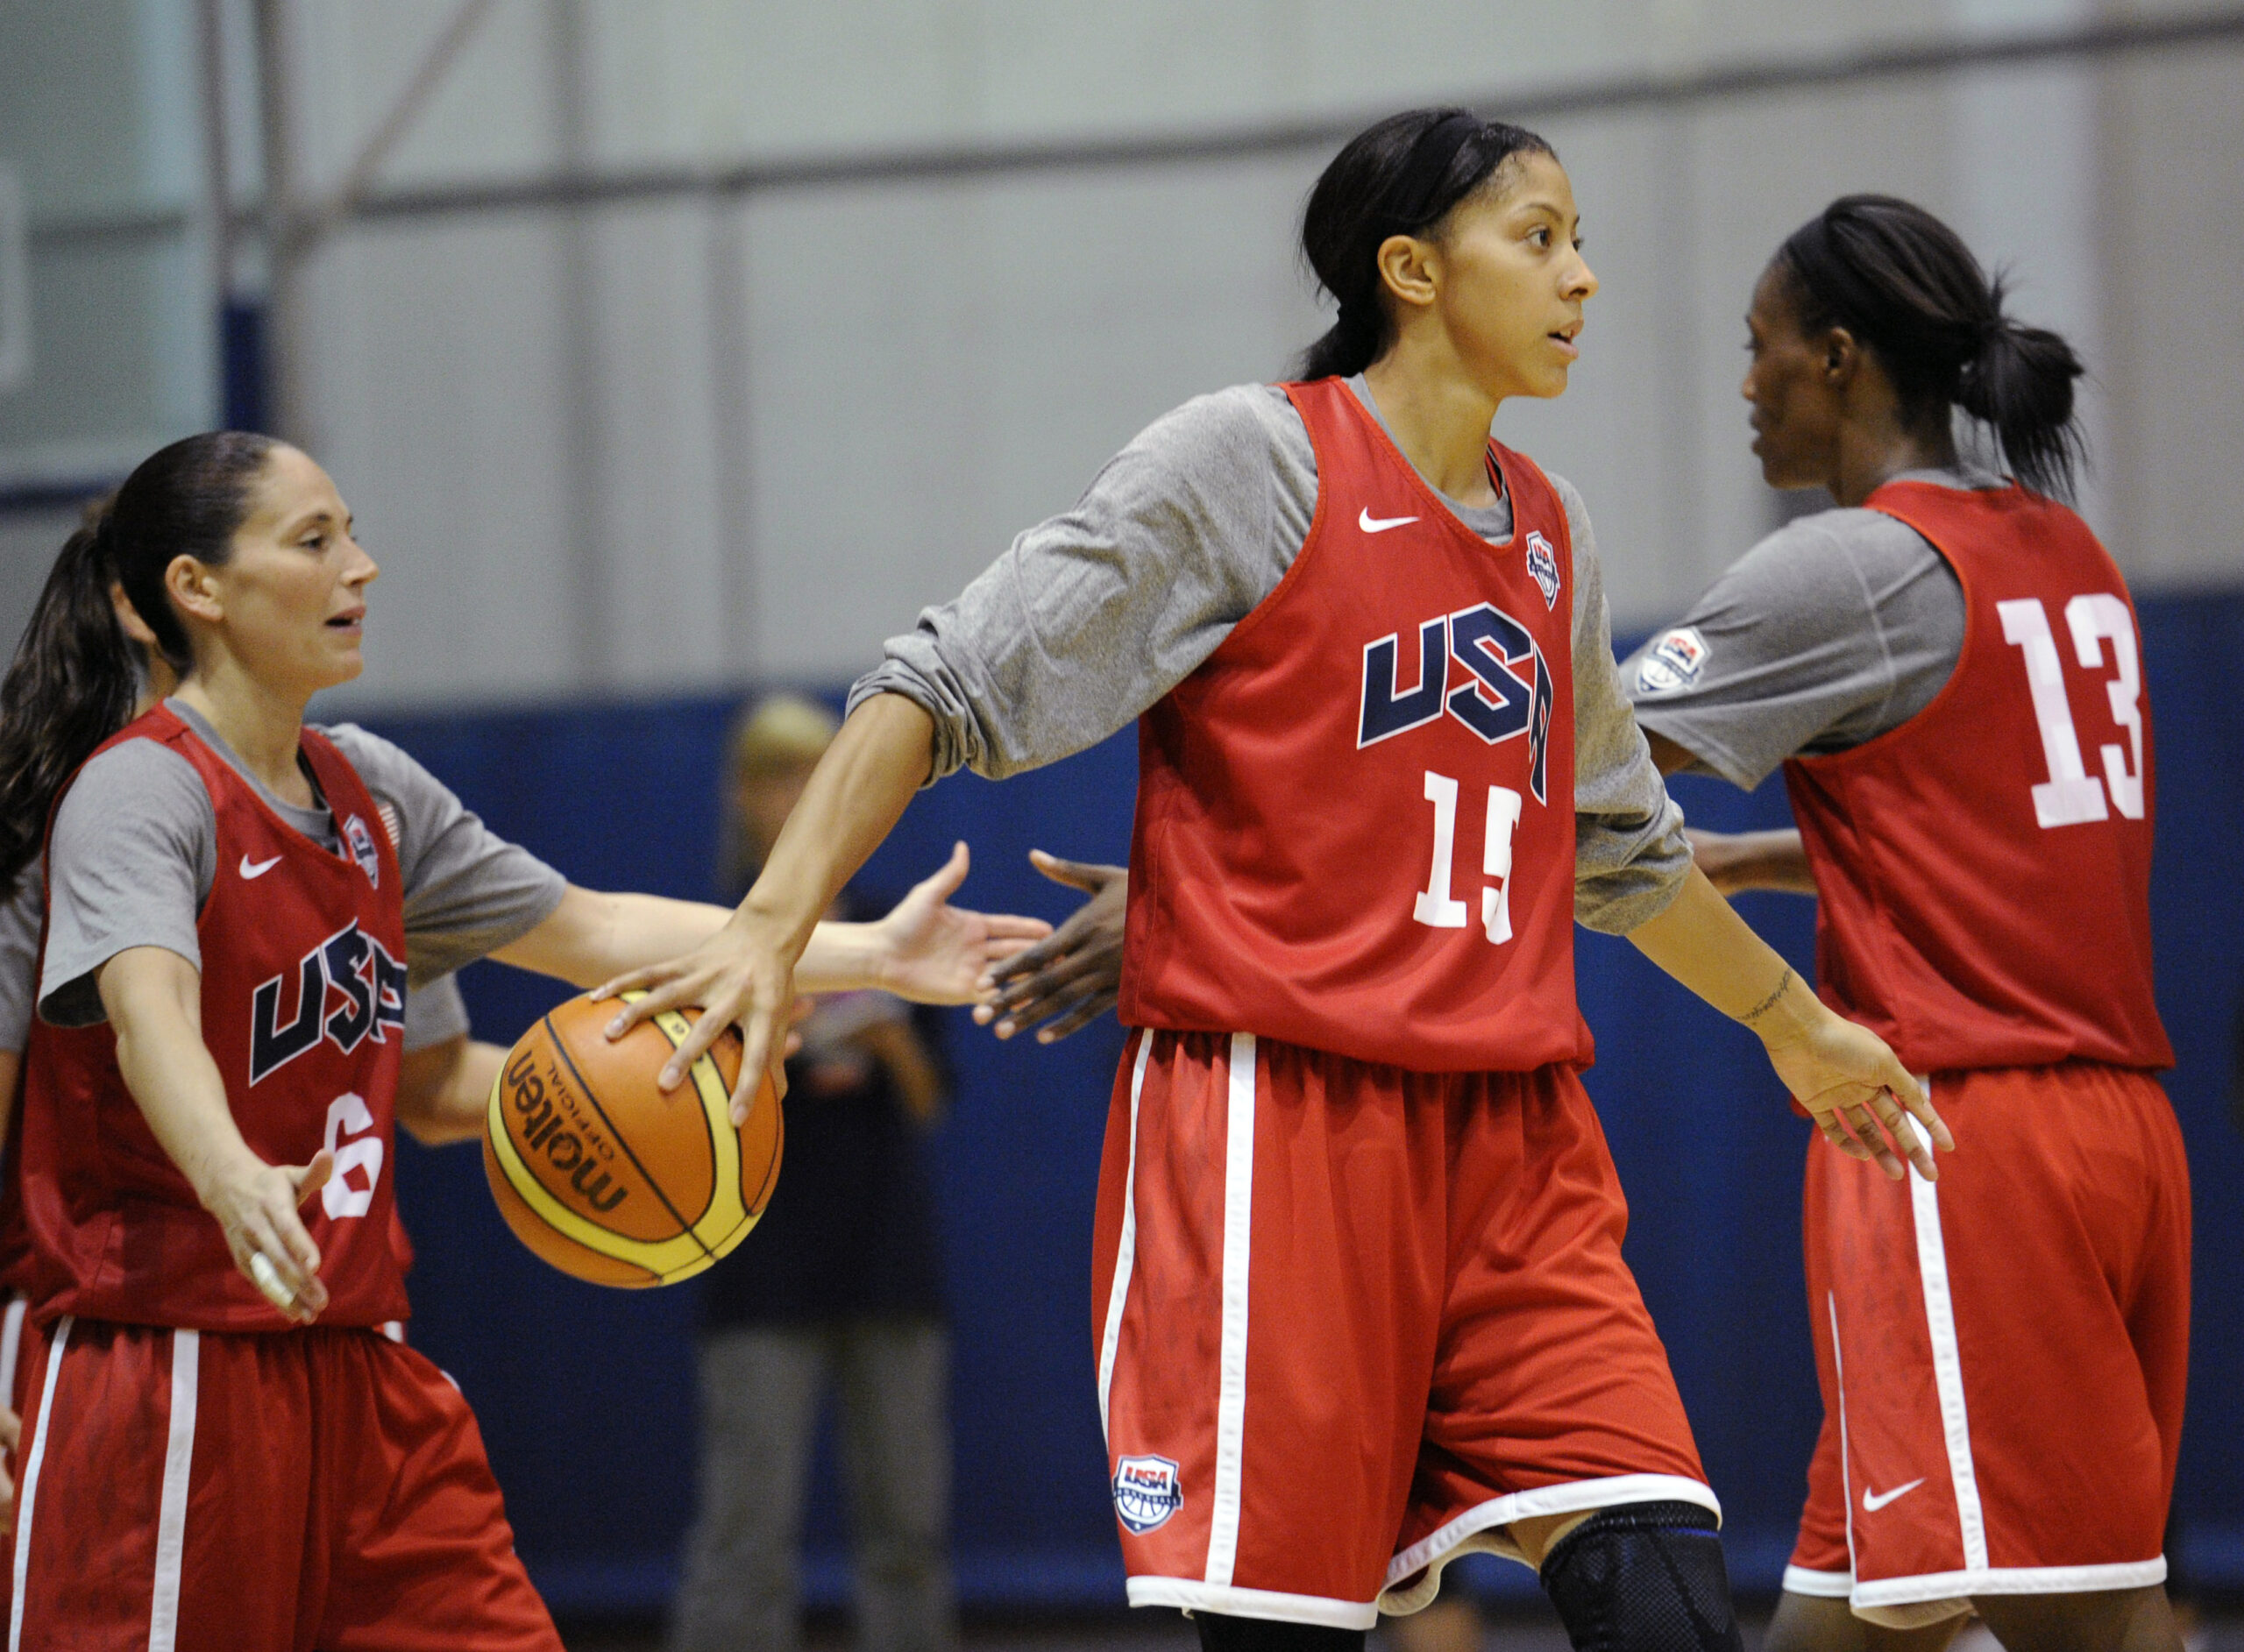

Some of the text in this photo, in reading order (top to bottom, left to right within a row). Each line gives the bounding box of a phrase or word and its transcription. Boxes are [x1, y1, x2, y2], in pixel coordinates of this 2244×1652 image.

[1357, 601, 1553, 808] USA
[1996, 592, 2145, 829] 13
[1413, 770, 1523, 945] 15
[249, 917, 408, 1088] USA
[321, 1092, 383, 1221] 6
[508, 1050, 628, 1213] molten
[1124, 1465, 1168, 1491] USA
